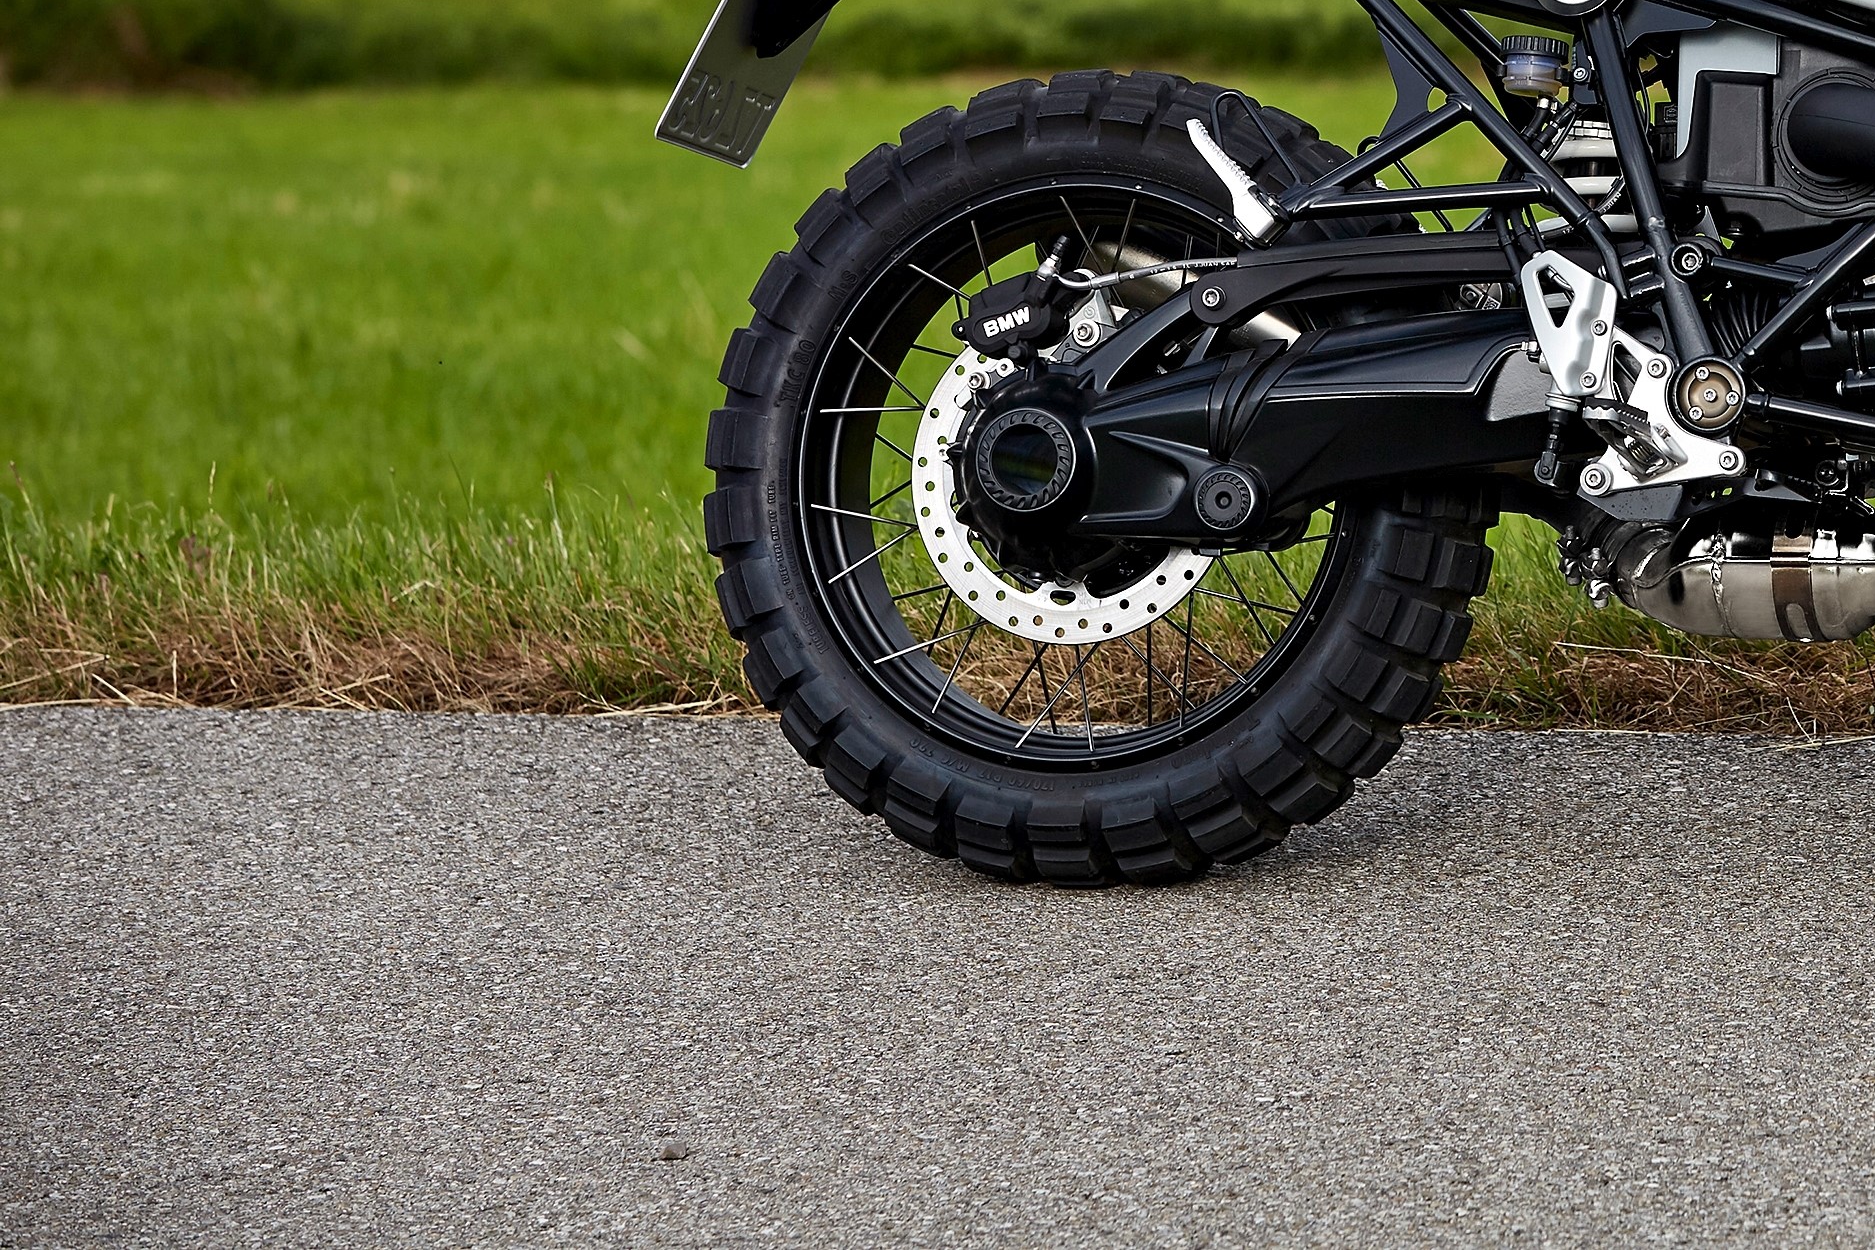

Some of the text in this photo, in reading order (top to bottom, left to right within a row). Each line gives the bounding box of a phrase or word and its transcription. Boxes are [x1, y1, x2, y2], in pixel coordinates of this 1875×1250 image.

[982, 306, 1031, 338] BMW
[776, 336, 817, 405] TKC 80
